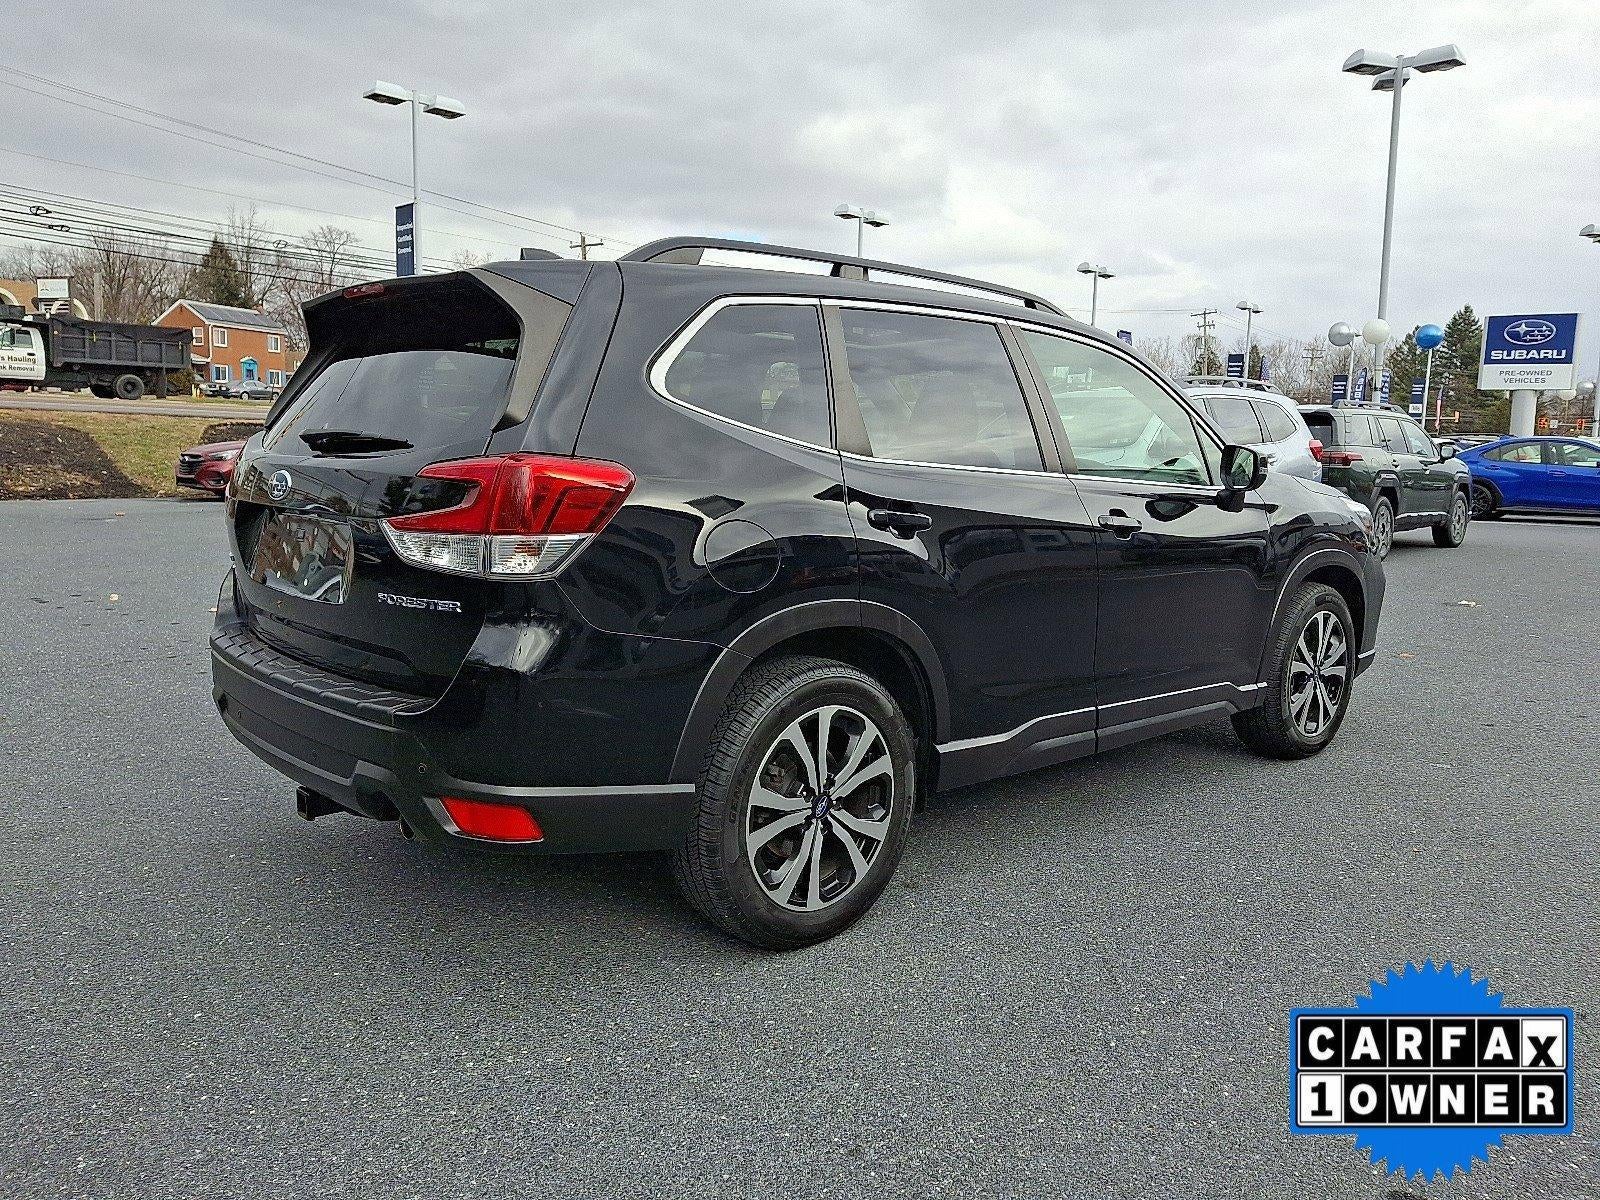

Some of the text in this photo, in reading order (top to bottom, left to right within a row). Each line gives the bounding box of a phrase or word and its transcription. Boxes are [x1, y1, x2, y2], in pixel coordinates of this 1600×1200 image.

[1491, 350, 1566, 359] SUBARU
[8, 355, 36, 365] Hauling
[378, 592, 461, 612] FORESTER
